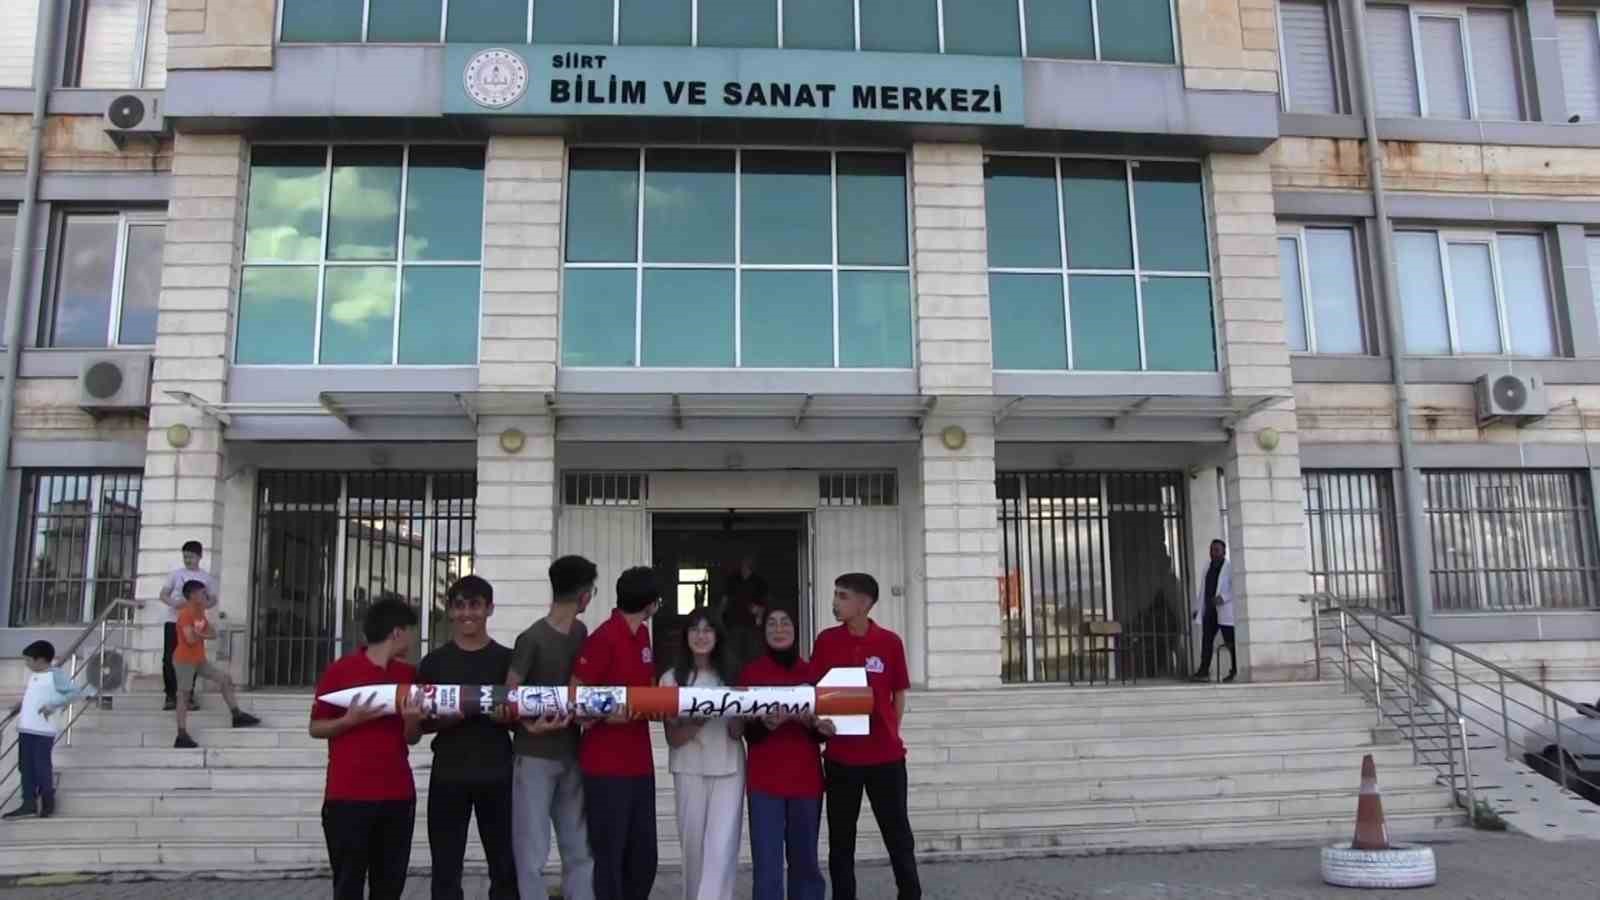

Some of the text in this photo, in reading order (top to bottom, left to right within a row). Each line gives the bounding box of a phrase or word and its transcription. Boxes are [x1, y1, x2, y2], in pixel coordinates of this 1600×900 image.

[552, 52, 607, 69] SİİRT
[550, 74, 1002, 113] BİLİM VE SANAT MERKEZİ
